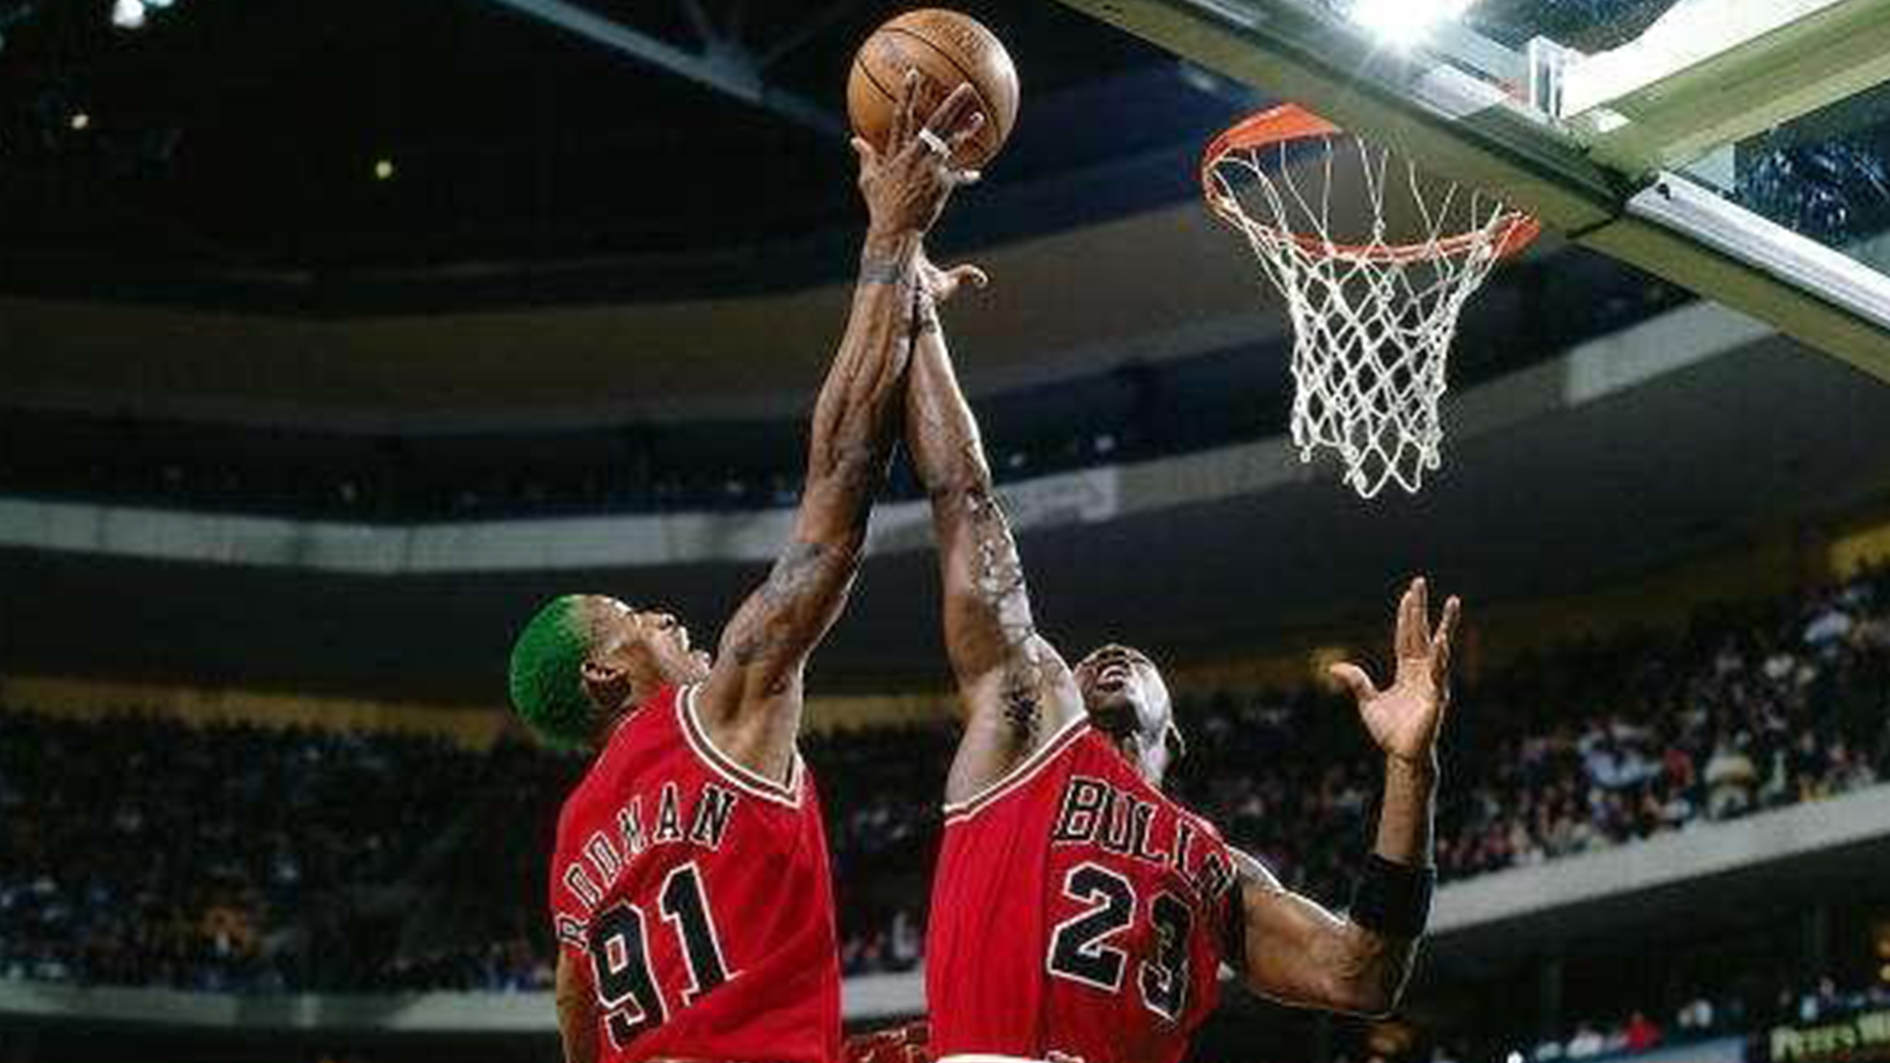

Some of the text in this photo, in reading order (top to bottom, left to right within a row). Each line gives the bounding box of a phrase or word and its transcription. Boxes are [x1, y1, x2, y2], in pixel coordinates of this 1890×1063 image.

[556, 781, 738, 949] RODMAN
[1047, 861, 1195, 1026] 23
[590, 861, 746, 1052] 91
